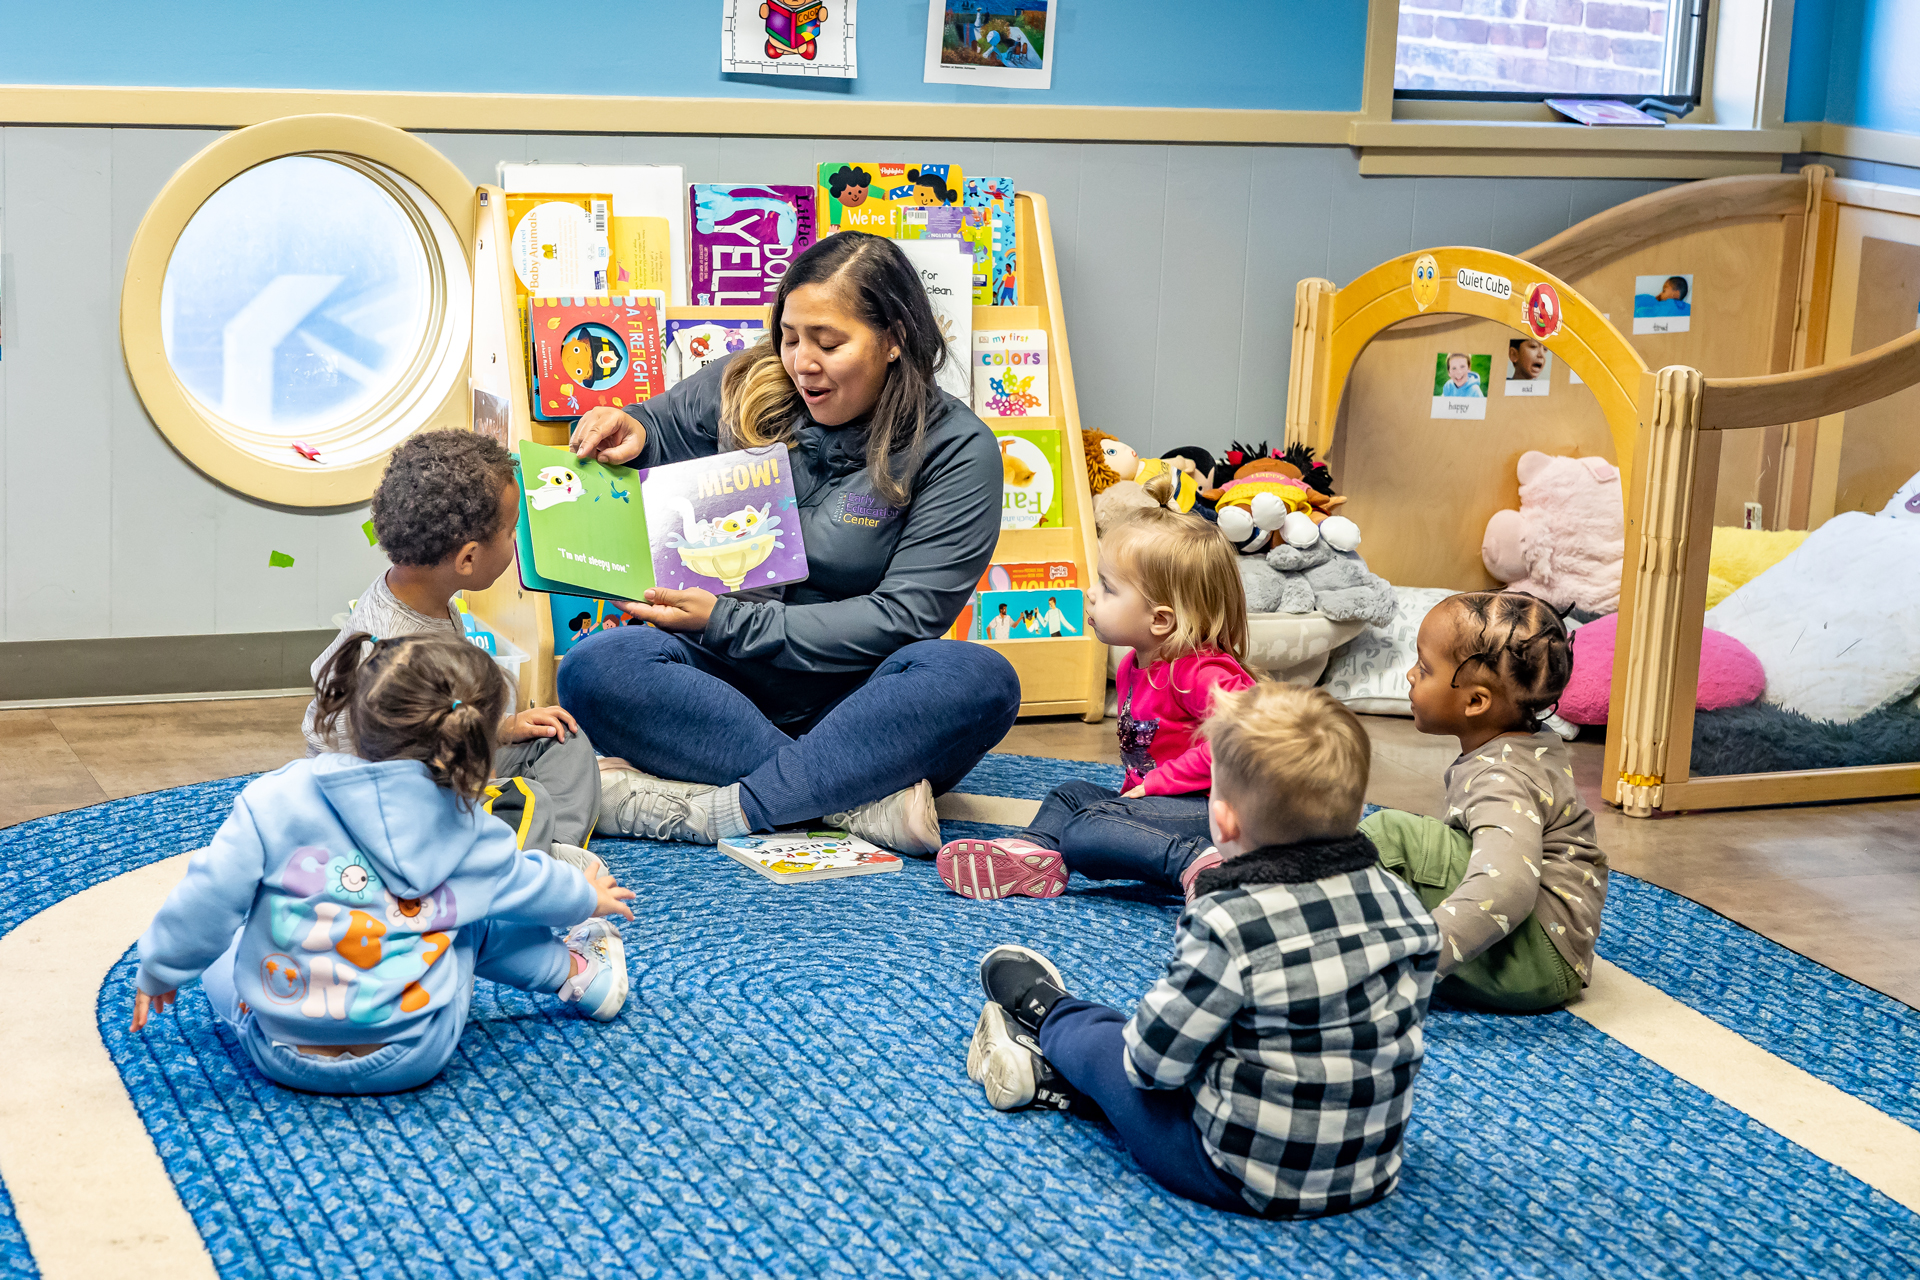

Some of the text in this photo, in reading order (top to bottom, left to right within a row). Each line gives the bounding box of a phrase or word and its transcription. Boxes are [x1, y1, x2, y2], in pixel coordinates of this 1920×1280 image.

[795, 194, 811, 247] Little
[847, 208, 886, 225] We're
[527, 211, 541, 289] Baby Animals
[711, 214, 762, 306] YELL
[920, 269, 939, 281] for
[1458, 269, 1510, 296] Quiet Cube
[926, 285, 954, 296] clean.
[625, 307, 641, 317] A
[648, 333, 656, 352] Want
[992, 335, 1006, 344] my
[1009, 332, 1029, 342] first
[627, 320, 651, 405] FIREFIGHTE
[650, 354, 657, 364] To
[982, 348, 1041, 366] colors
[1521, 383, 1533, 393] sad
[1448, 401, 1470, 414] happy
[697, 458, 781, 500] MEOW!
[848, 492, 875, 506] Early
[1002, 491, 1042, 515] Far
[846, 503, 899, 518] Education
[843, 513, 880, 527] Center
[574, 552, 587, 564] not
[588, 555, 611, 572] sleepy
[753, 840, 853, 855] MONSTER
[775, 847, 851, 858] COLOR
